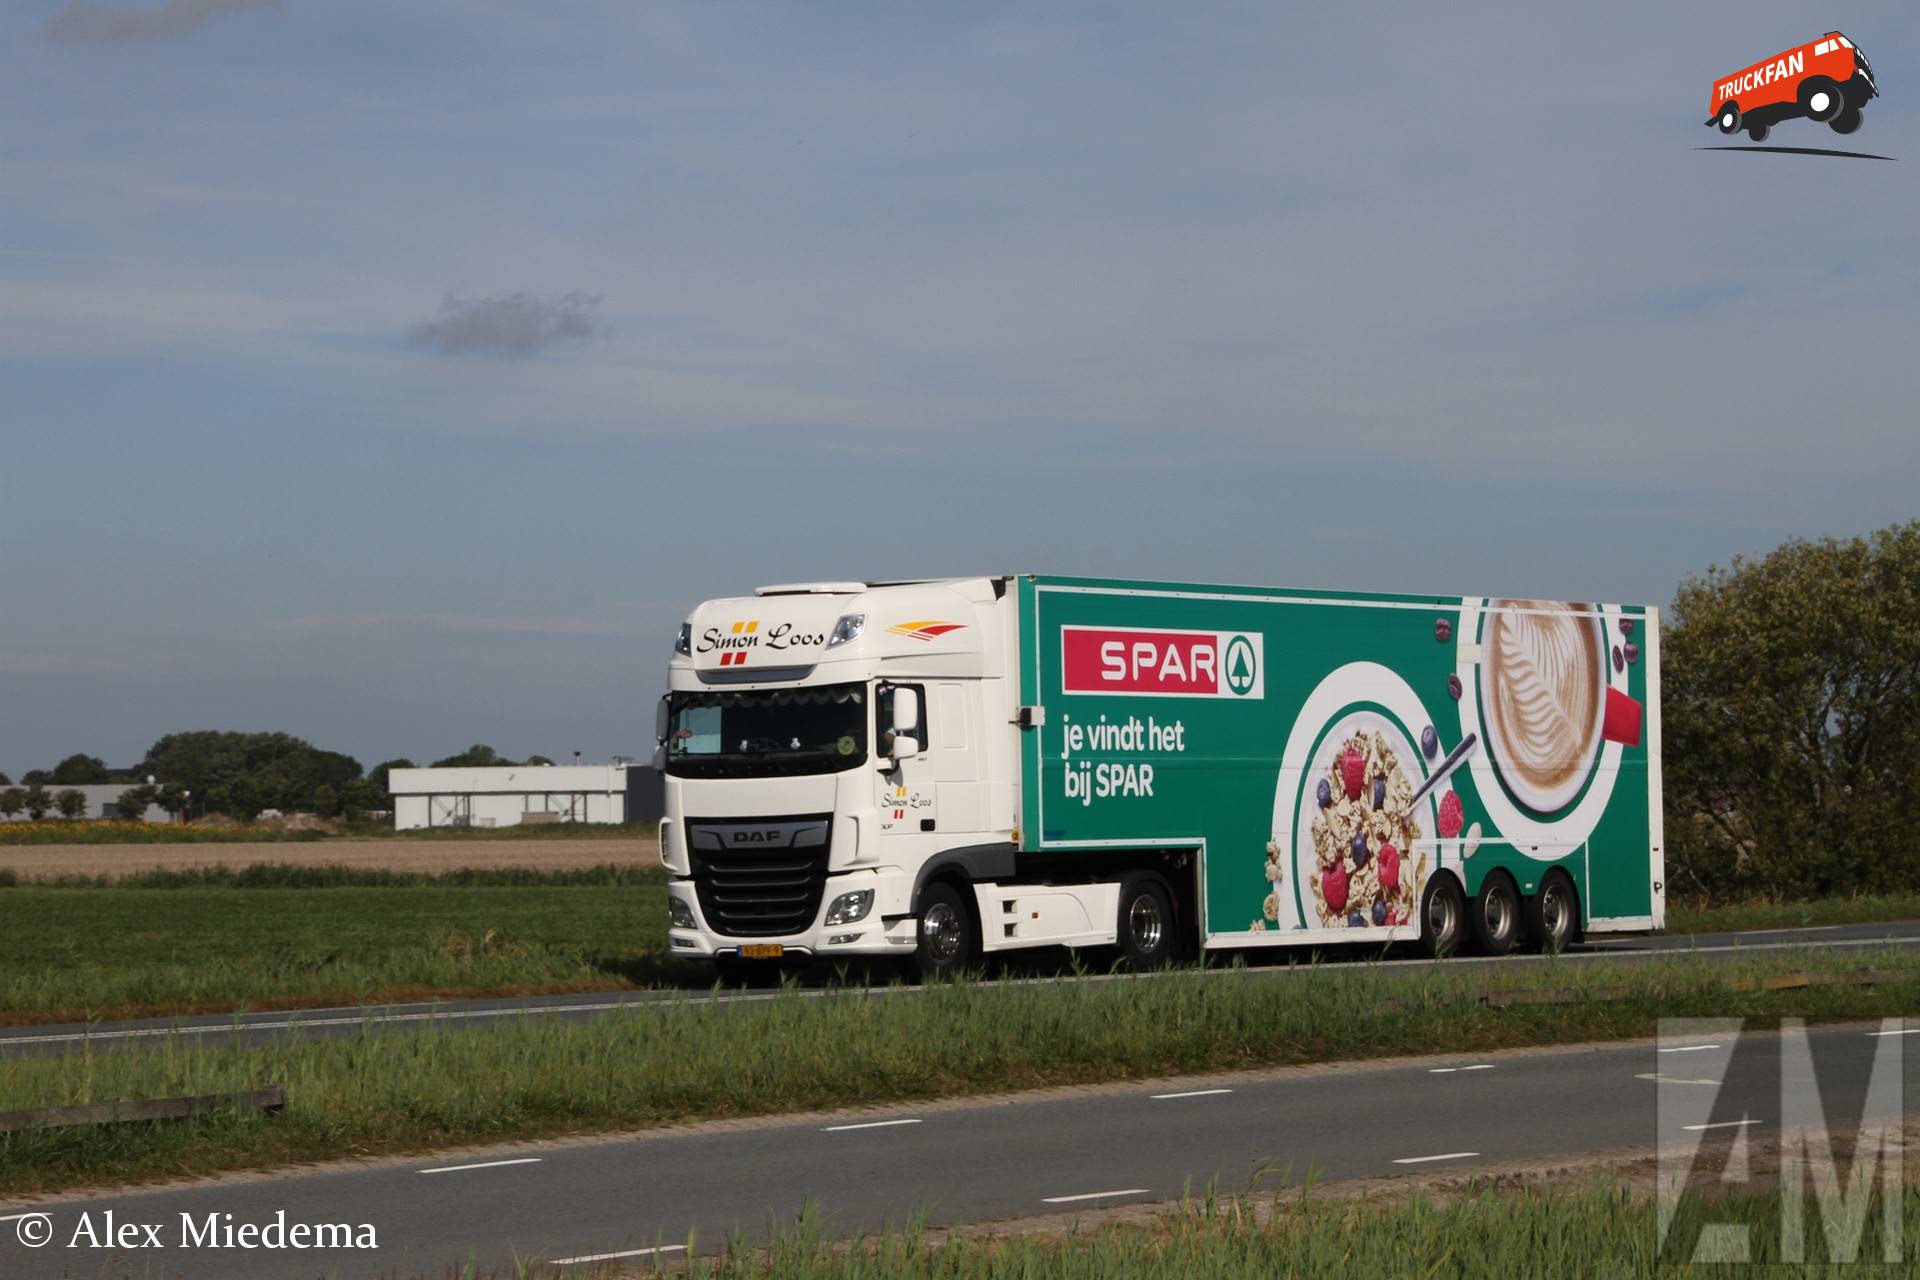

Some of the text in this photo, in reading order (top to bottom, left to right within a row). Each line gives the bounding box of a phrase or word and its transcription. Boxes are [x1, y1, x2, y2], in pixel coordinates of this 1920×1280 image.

[696, 623, 825, 653] Simon Loos
[1101, 641, 1216, 683] SPAR
[1061, 714, 1184, 759] je vindt het
[881, 792, 932, 809] Simon Loos
[1064, 761, 1154, 806] bij SPAR
[733, 830, 781, 843] DAF
